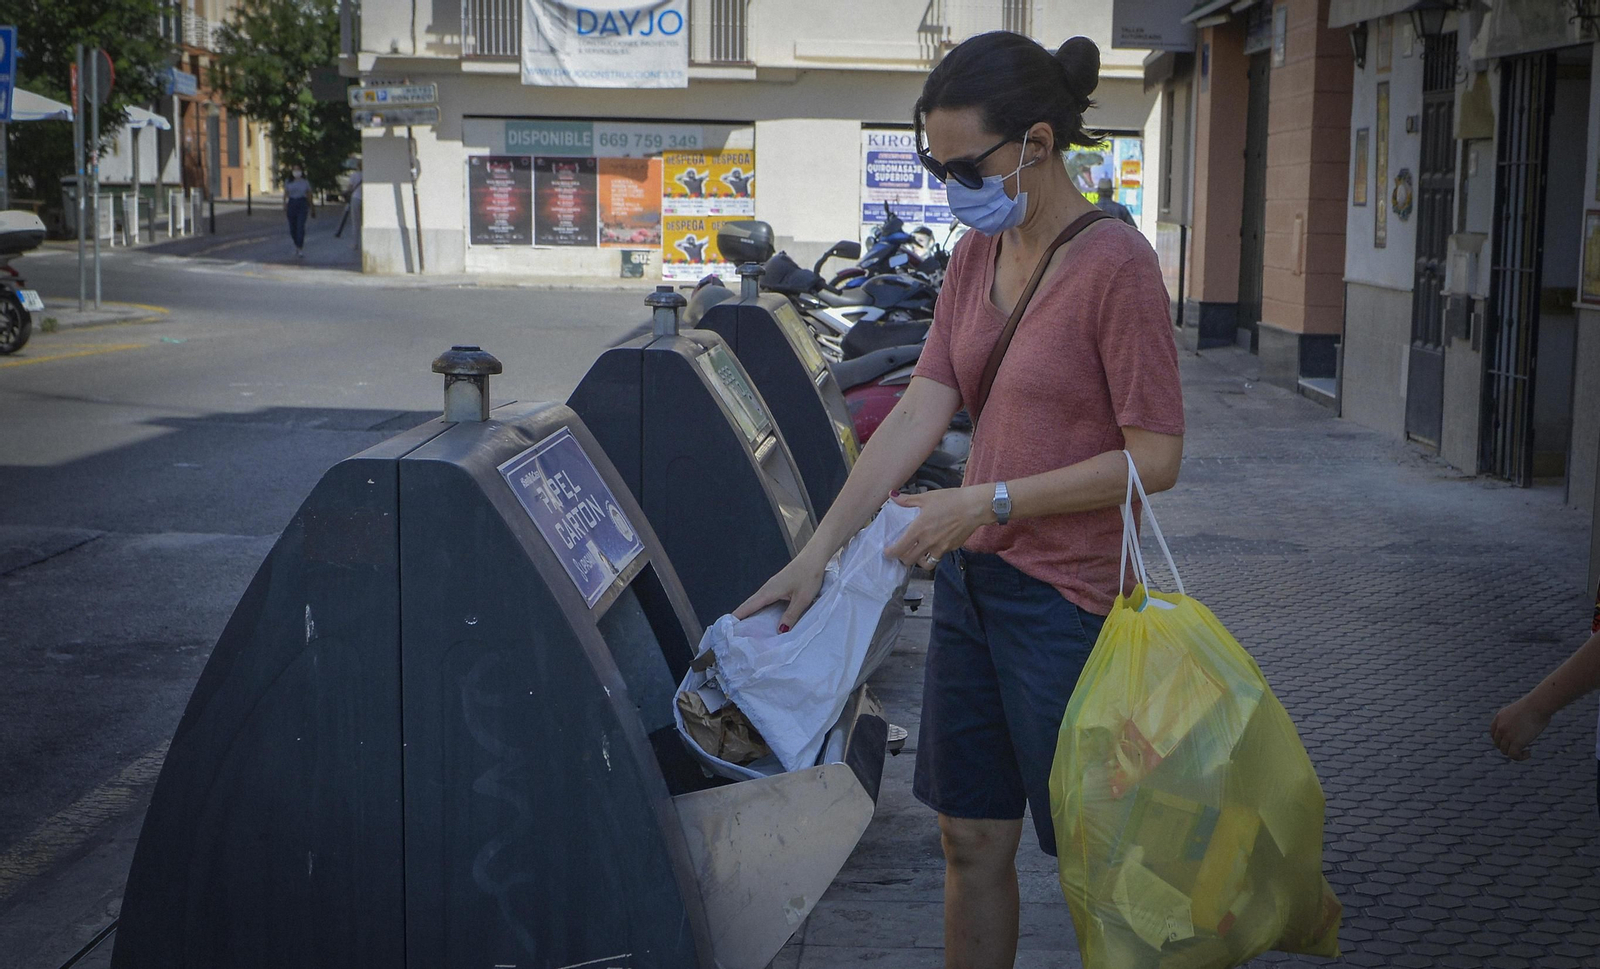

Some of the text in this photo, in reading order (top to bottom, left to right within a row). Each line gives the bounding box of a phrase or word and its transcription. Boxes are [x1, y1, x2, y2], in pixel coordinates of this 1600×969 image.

[577, 8, 684, 36] DAYJO
[507, 130, 698, 149] DISPONIBLE 669 759 349
[667, 153, 705, 166] DESPEGA
[712, 152, 751, 165] DESPEGA
[867, 164, 923, 174] QUIROMASAJE
[874, 172, 915, 182] SUPERIOR
[666, 219, 705, 231] DESPEGA
